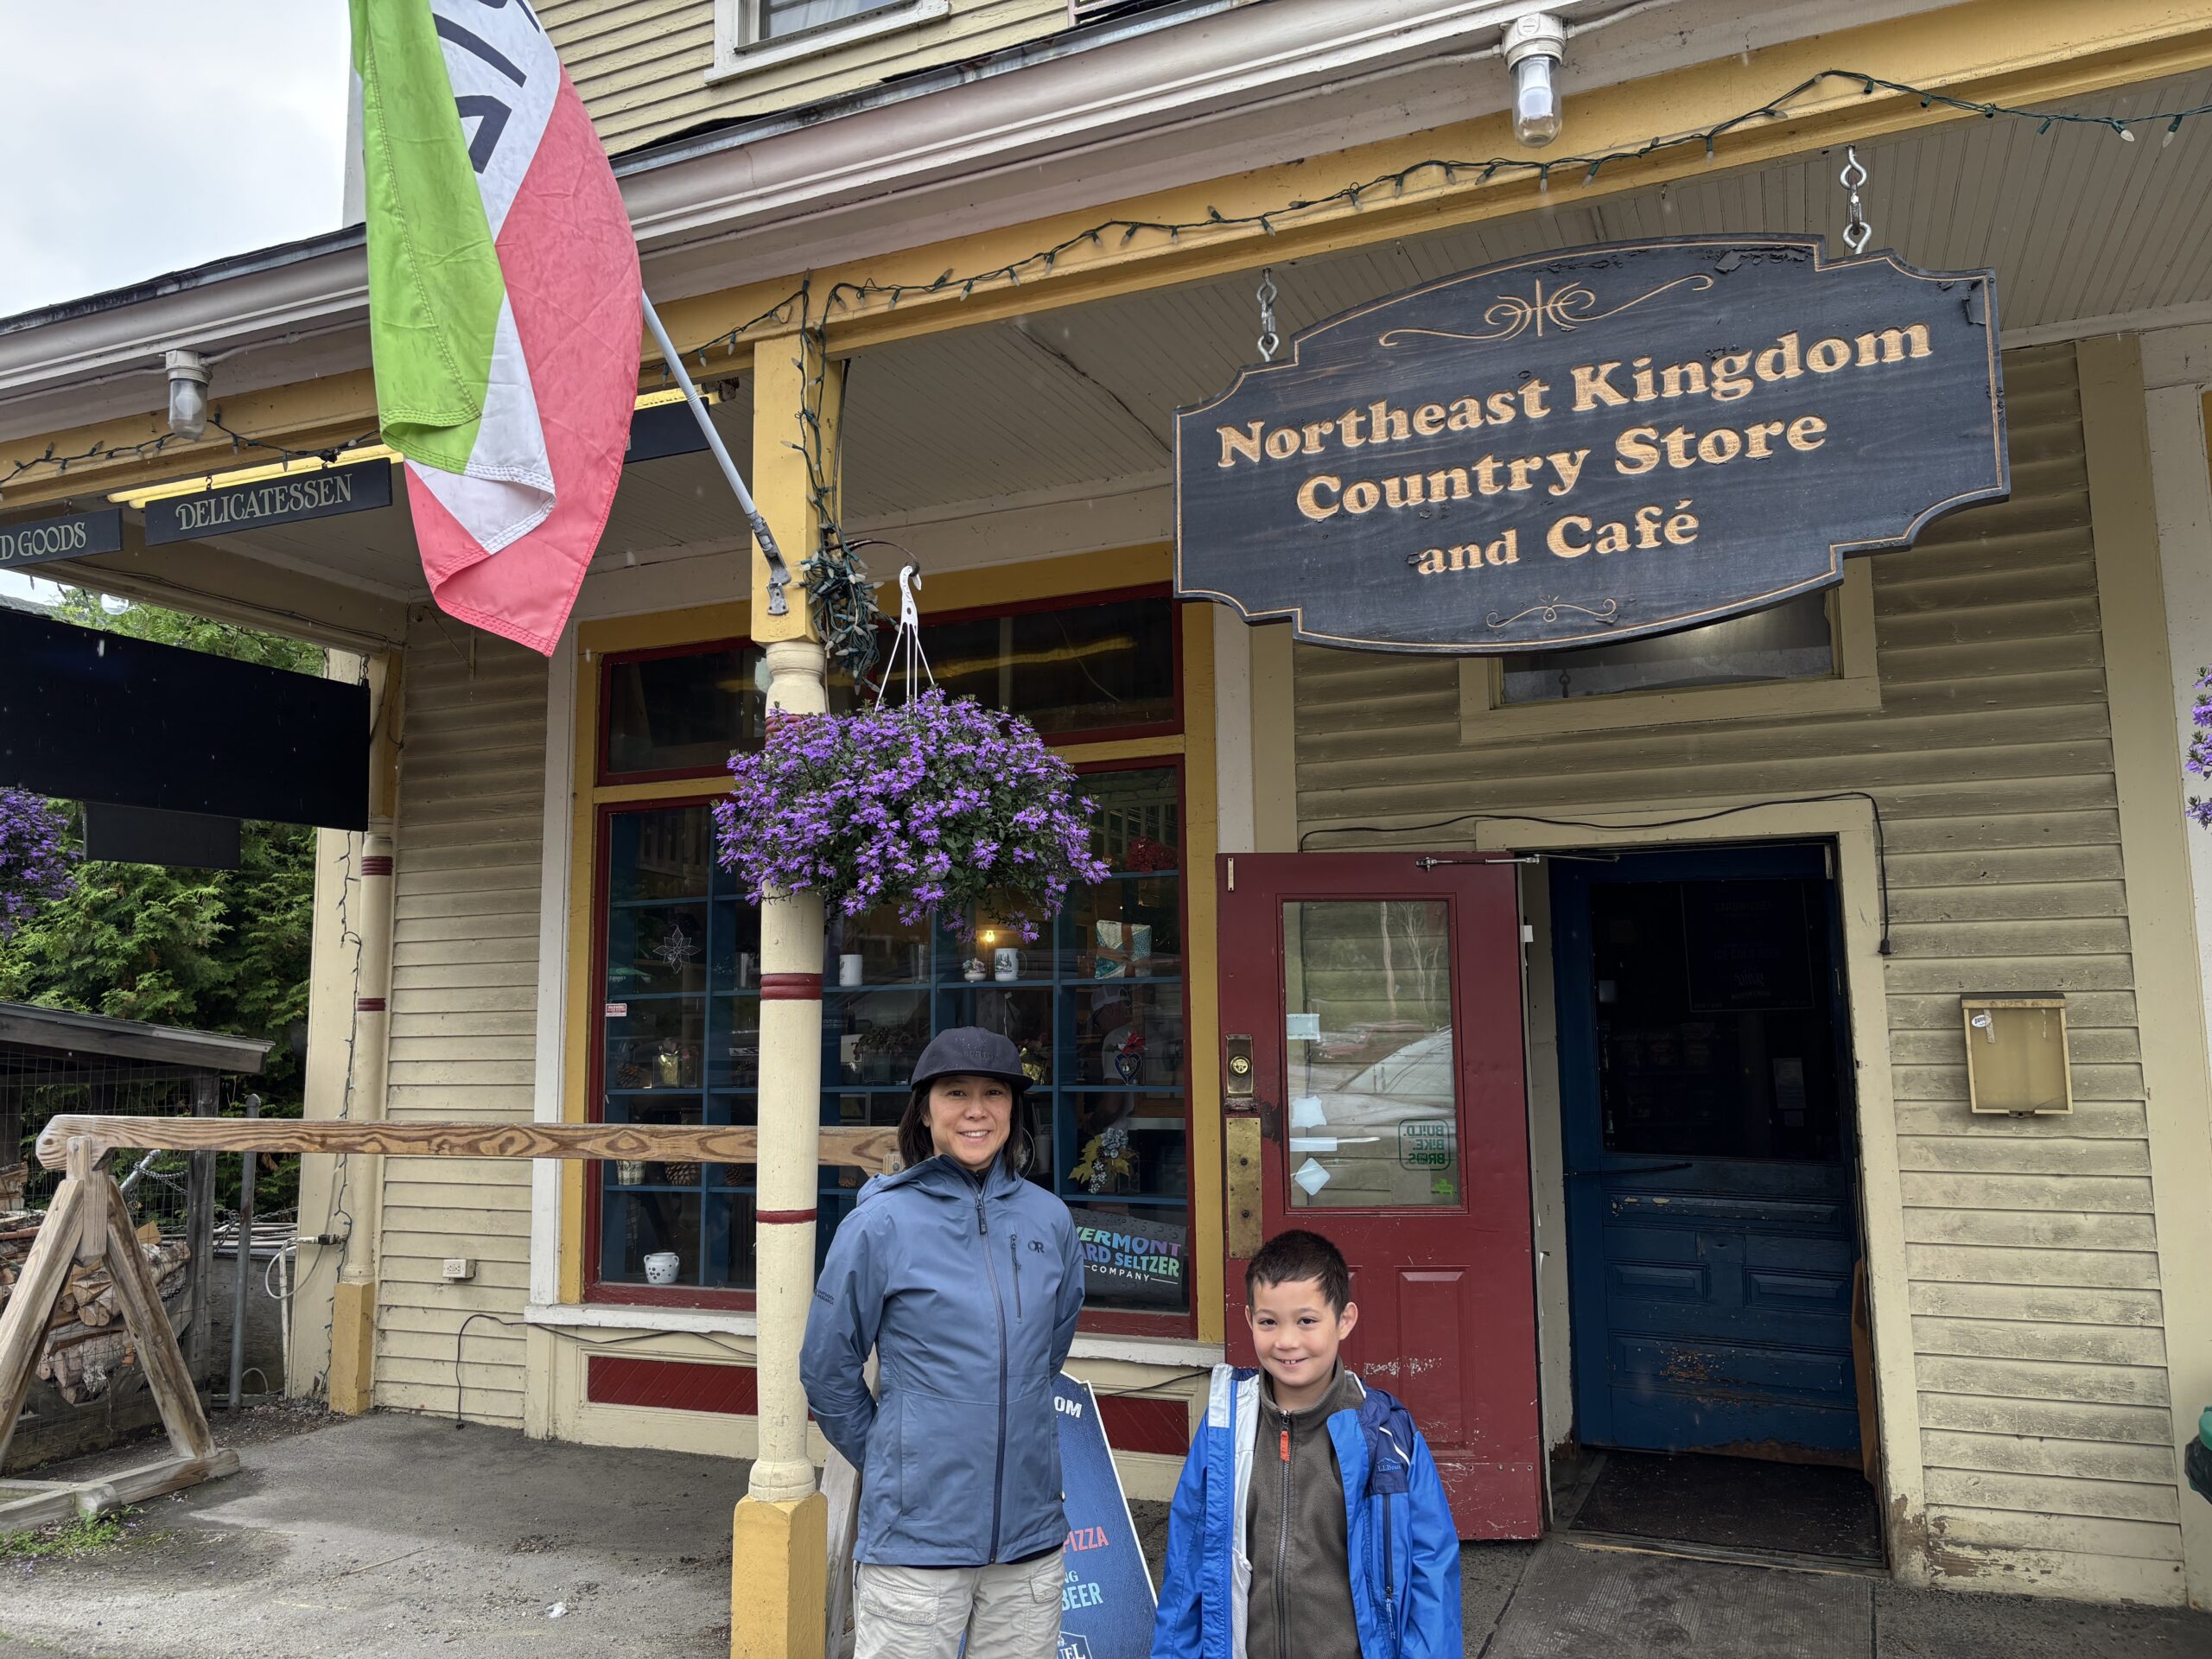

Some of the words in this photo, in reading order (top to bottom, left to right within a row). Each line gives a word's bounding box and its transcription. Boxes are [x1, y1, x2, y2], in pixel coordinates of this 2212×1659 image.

[1216, 378, 1551, 467] Northeast
[1571, 321, 1933, 411] Kingdom
[1297, 448, 1590, 519] Country
[1615, 415, 1827, 474] Store
[175, 474, 353, 531] DELICATESSEN
[18, 521, 86, 556] GOODS
[1417, 527, 1519, 575] and
[1546, 498, 1699, 558] Café
[1091, 1264, 1150, 1282] COMPANY
[1115, 1252, 1179, 1277] SELTZER
